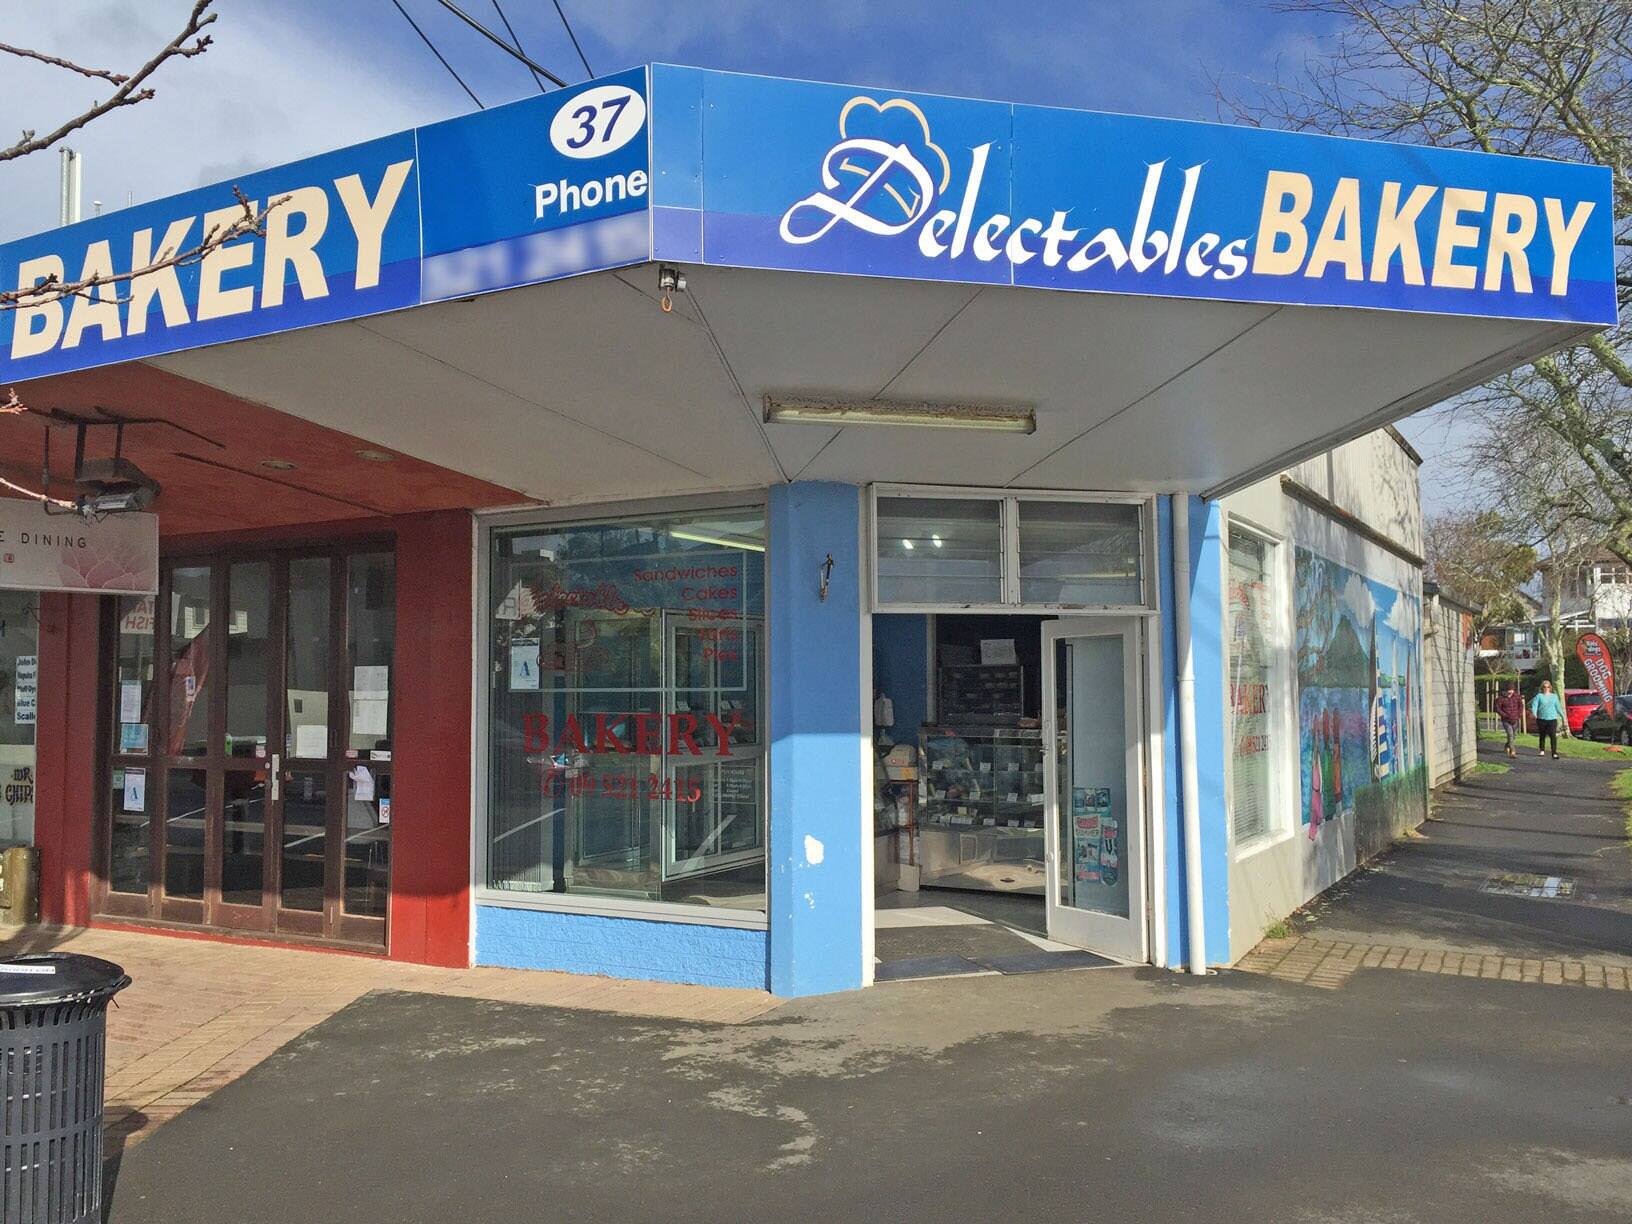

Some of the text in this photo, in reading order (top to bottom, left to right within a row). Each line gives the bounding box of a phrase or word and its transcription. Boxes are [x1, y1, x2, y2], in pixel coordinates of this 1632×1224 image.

[567, 95, 631, 149] 37
[535, 170, 648, 219] Phone
[779, 137, 1249, 280] Delectables
[1252, 169, 1596, 296] BAKERY
[11, 159, 414, 360] BAKERY
[21, 532, 87, 548] DINING
[633, 566, 737, 583] Sandwiches
[682, 586, 737, 600] Cakes
[1584, 658, 1613, 703] GROOMING
[1595, 658, 1612, 680] DOG
[522, 712, 742, 757] BAKERY
